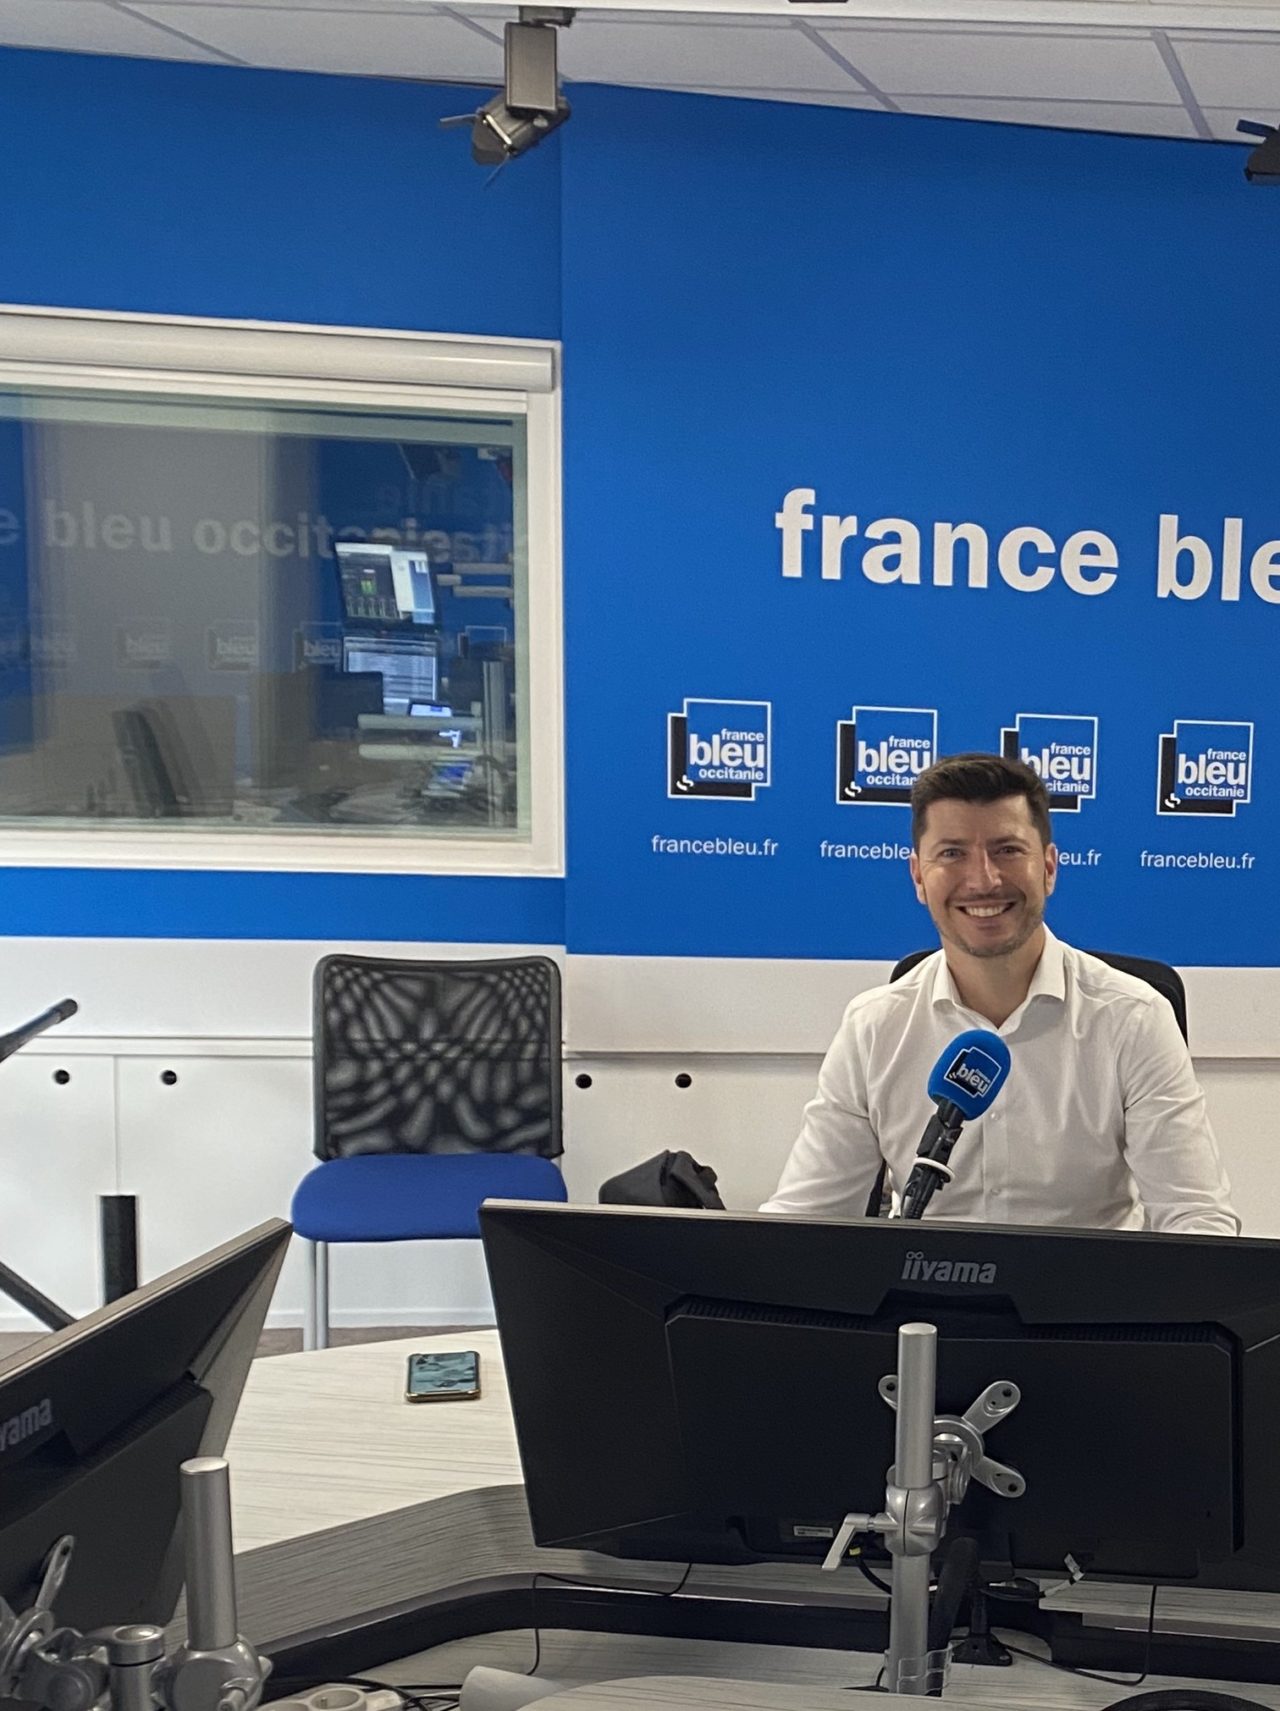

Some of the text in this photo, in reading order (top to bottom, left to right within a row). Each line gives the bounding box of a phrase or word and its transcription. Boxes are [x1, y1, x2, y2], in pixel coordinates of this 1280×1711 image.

[776, 488, 1118, 595] france
[721, 728, 764, 741] france
[889, 735, 931, 749] france
[690, 733, 765, 768] bleu
[858, 741, 931, 774] bleu
[1050, 742, 1091, 755] france
[1207, 748, 1246, 761] france
[698, 767, 764, 780] occitanie
[1178, 754, 1246, 785] bleu
[1045, 780, 1090, 793] citanie
[1185, 786, 1244, 797] occitanie
[652, 835, 779, 856] francebleu.fr
[820, 840, 911, 860] franceble
[1140, 851, 1256, 869] francebleu.fr
[957, 1063, 988, 1094] bleu
[901, 1251, 997, 1284] iiyama
[0, 1398, 52, 1452] yama
